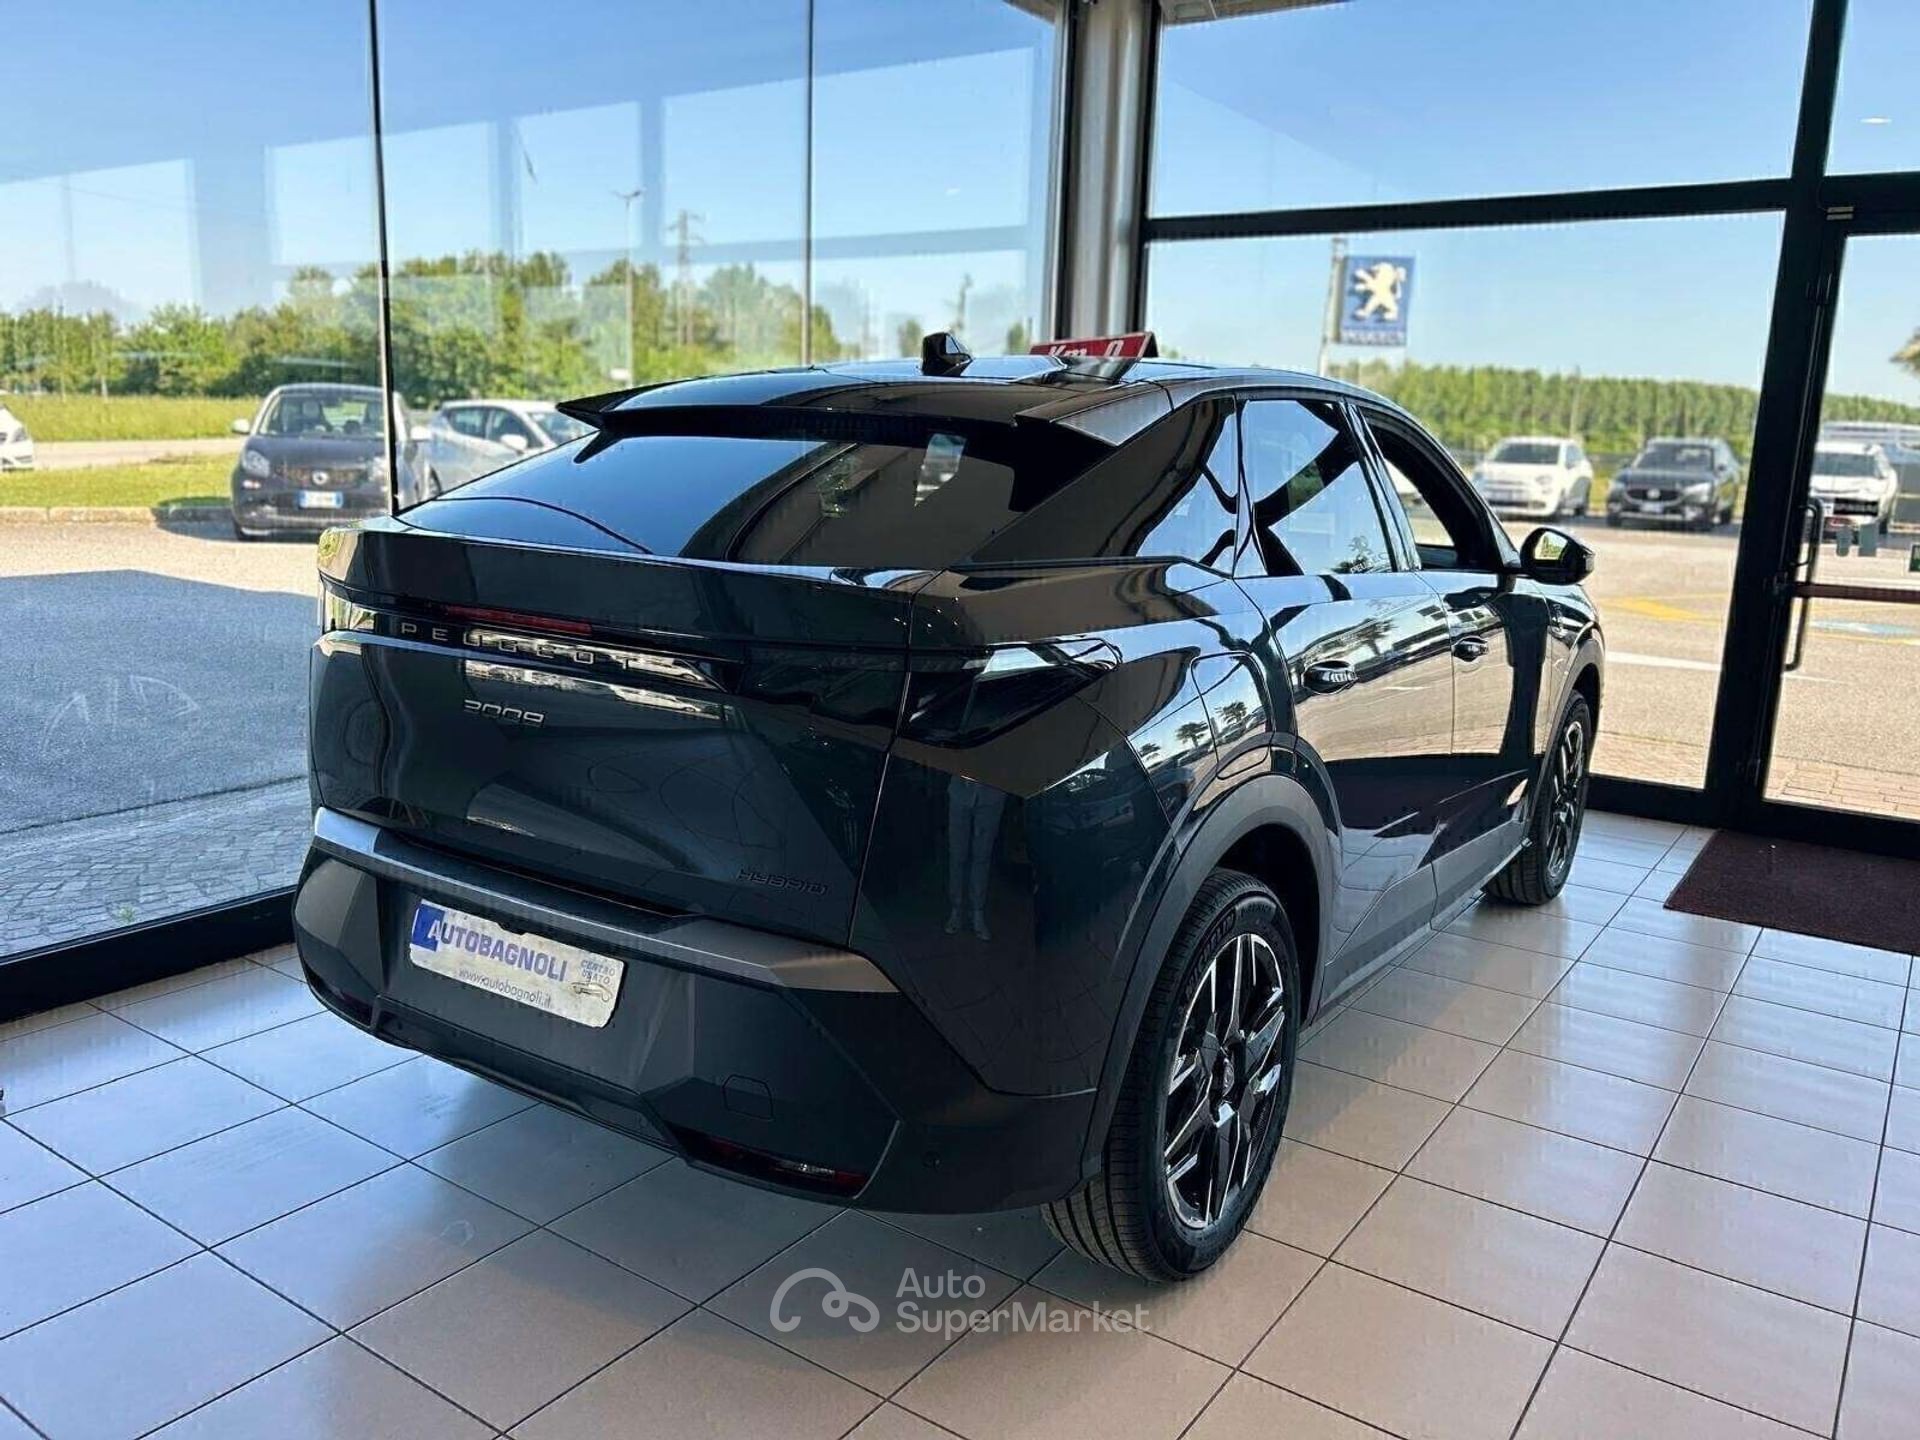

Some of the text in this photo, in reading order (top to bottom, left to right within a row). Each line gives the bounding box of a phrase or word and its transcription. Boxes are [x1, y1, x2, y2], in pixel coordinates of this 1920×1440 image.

[401, 621, 637, 671] PEUGEOT
[427, 919, 568, 982] AUTOBAGNOLI
[580, 959, 616, 977] CENTRO
[458, 967, 551, 1008] www.autobagnoli.it
